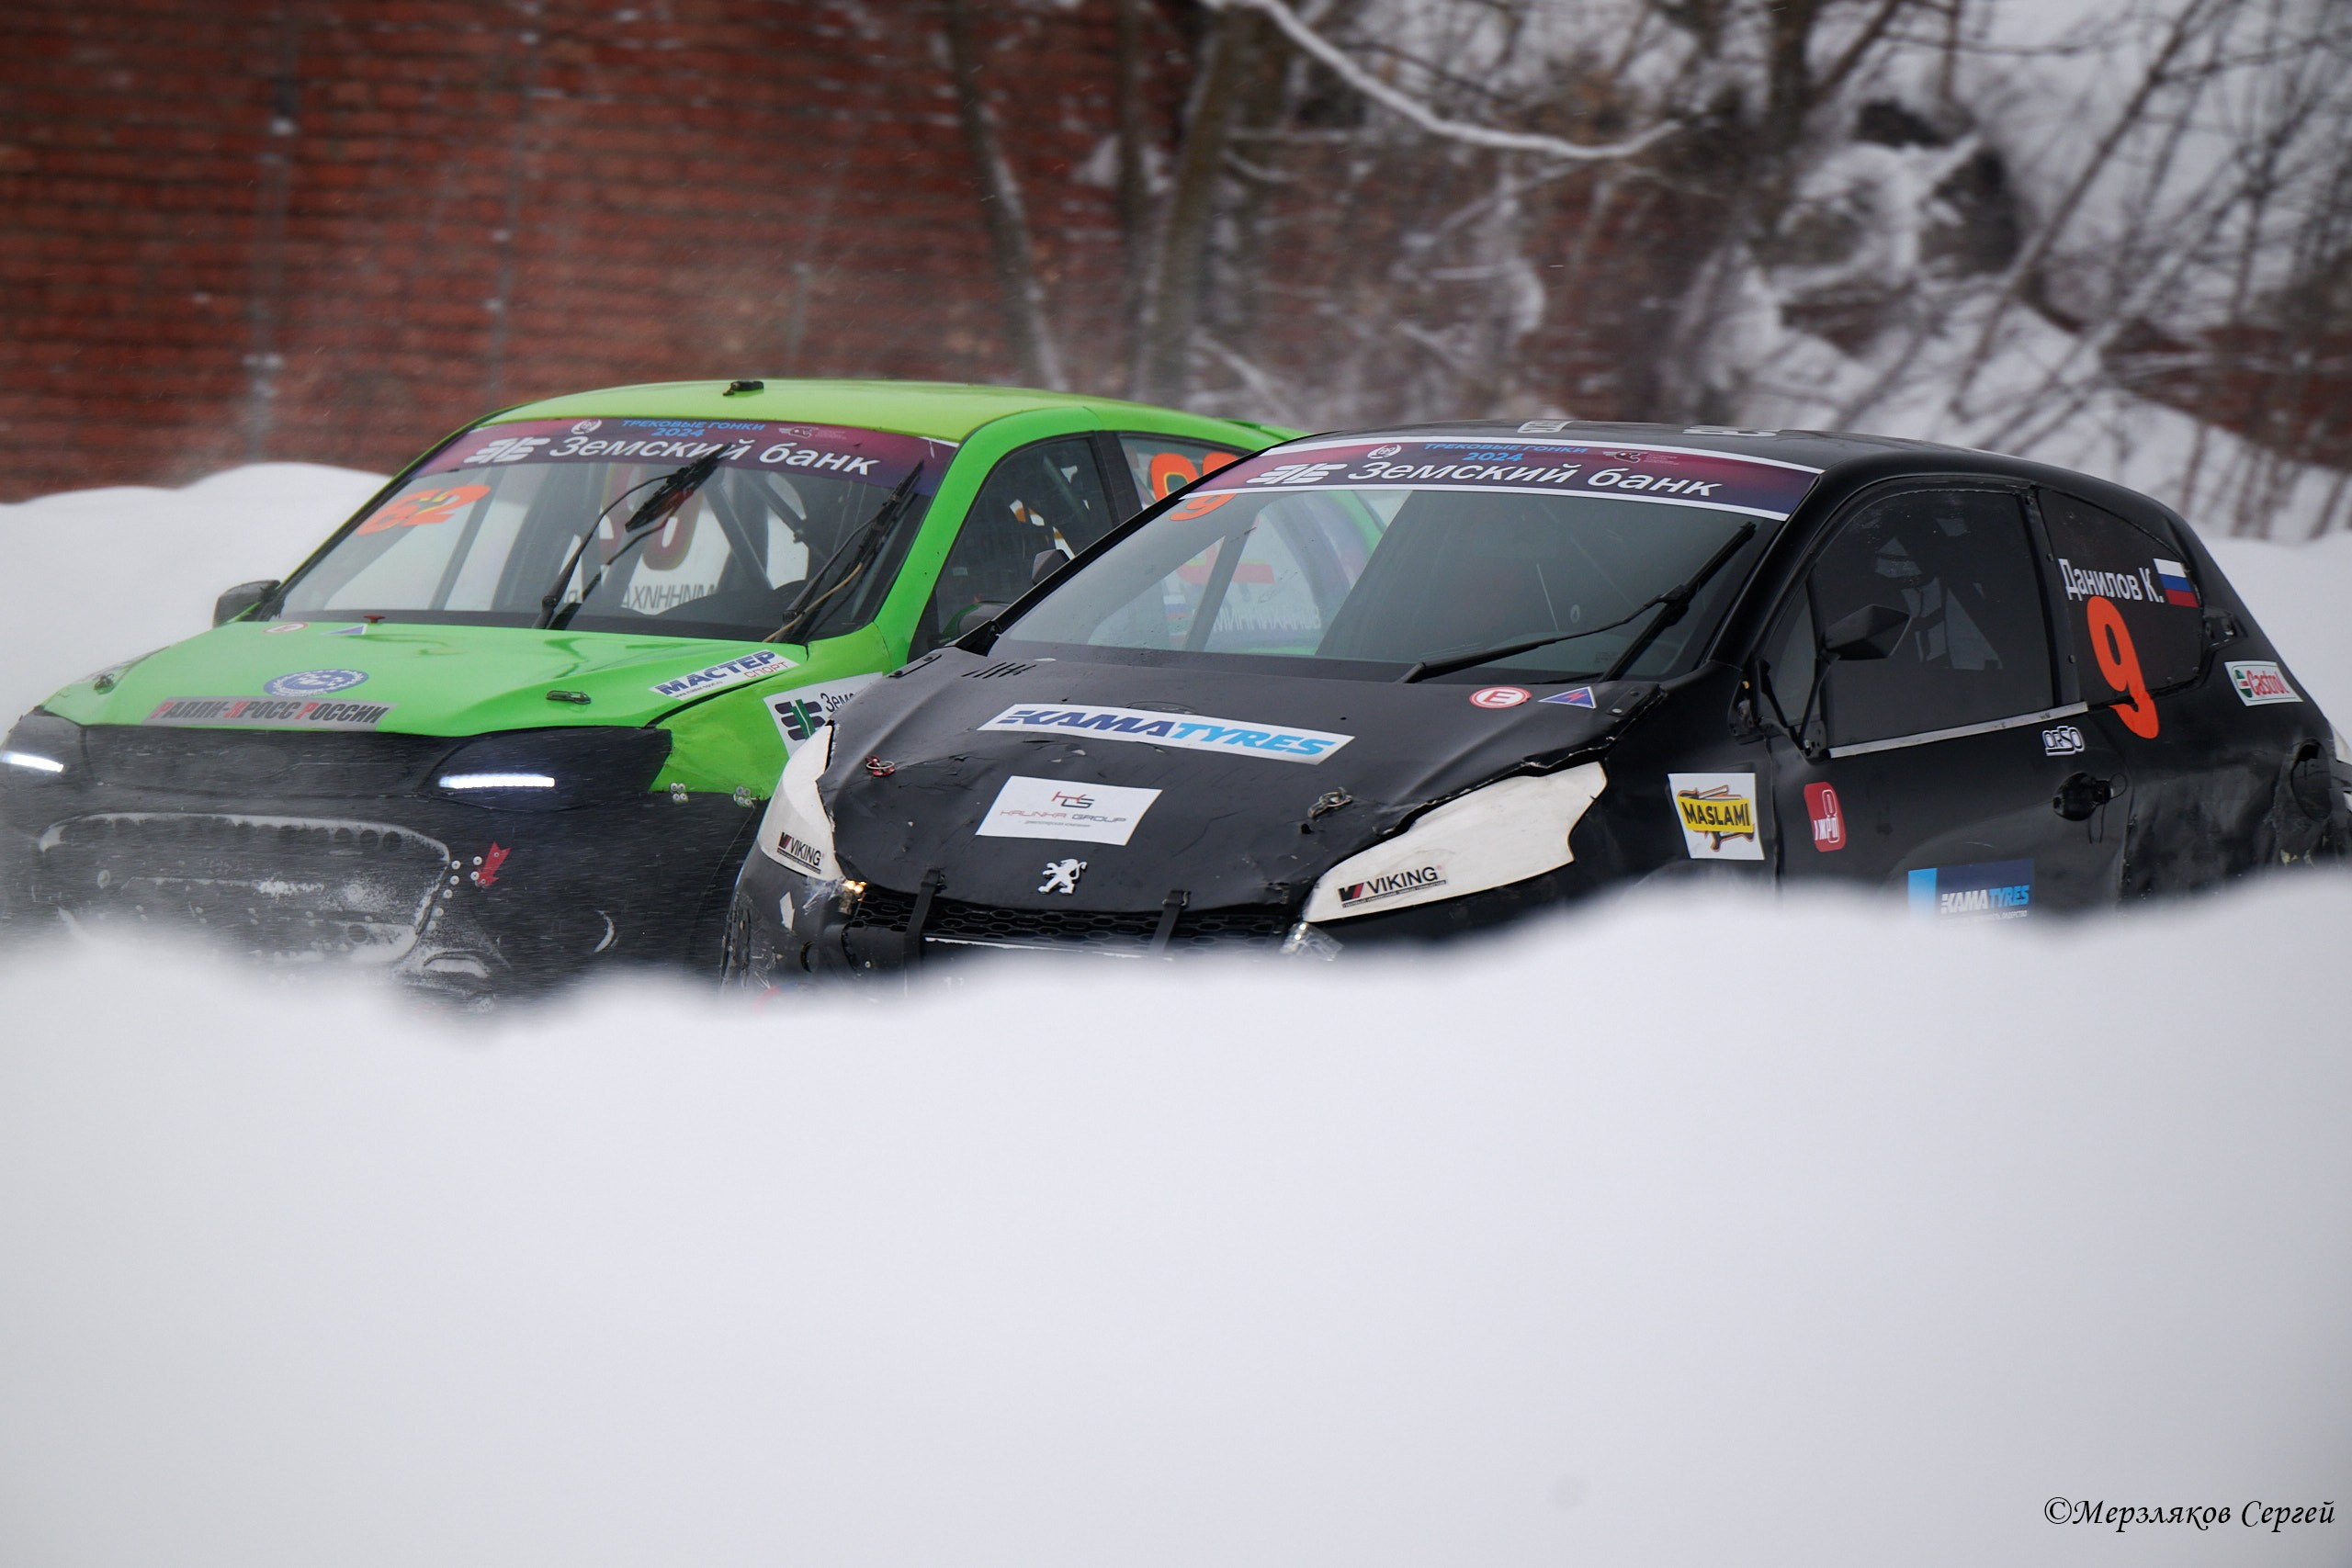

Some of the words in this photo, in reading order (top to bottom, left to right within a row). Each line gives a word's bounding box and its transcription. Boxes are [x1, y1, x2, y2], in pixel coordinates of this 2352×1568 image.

[622, 419, 707, 431] ТРЕКОВЫЕ
[707, 422, 765, 432] ГОНКИ
[650, 427, 705, 438] 2024
[548, 435, 757, 461] Земский
[759, 441, 881, 477] банк
[1423, 441, 1531, 453] ТРЕКОВЫЕ
[1532, 444, 1589, 455] ГОНКИ
[1463, 452, 1524, 463] 2024
[1348, 460, 1578, 484] Земский
[1588, 466, 1724, 498] банк
[355, 488, 492, 536] 62
[2058, 558, 2143, 601] Данилов
[2139, 567, 2165, 604] К.
[655, 650, 776, 696] МАСТЕР
[743, 661, 788, 678] СПОРТ
[2086, 595, 2159, 739] 9
[2245, 670, 2290, 696] Castrol
[1483, 690, 1517, 705] E
[293, 702, 390, 724] РОССИИ
[997, 710, 1335, 756] KAMATYRES
[1071, 814, 1127, 824] GROUP
[1680, 801, 1750, 827] MASLAMI
[790, 837, 821, 866] VIKING
[1367, 866, 1439, 895] VIKING
[1940, 885, 2030, 914] KAMATYRES
